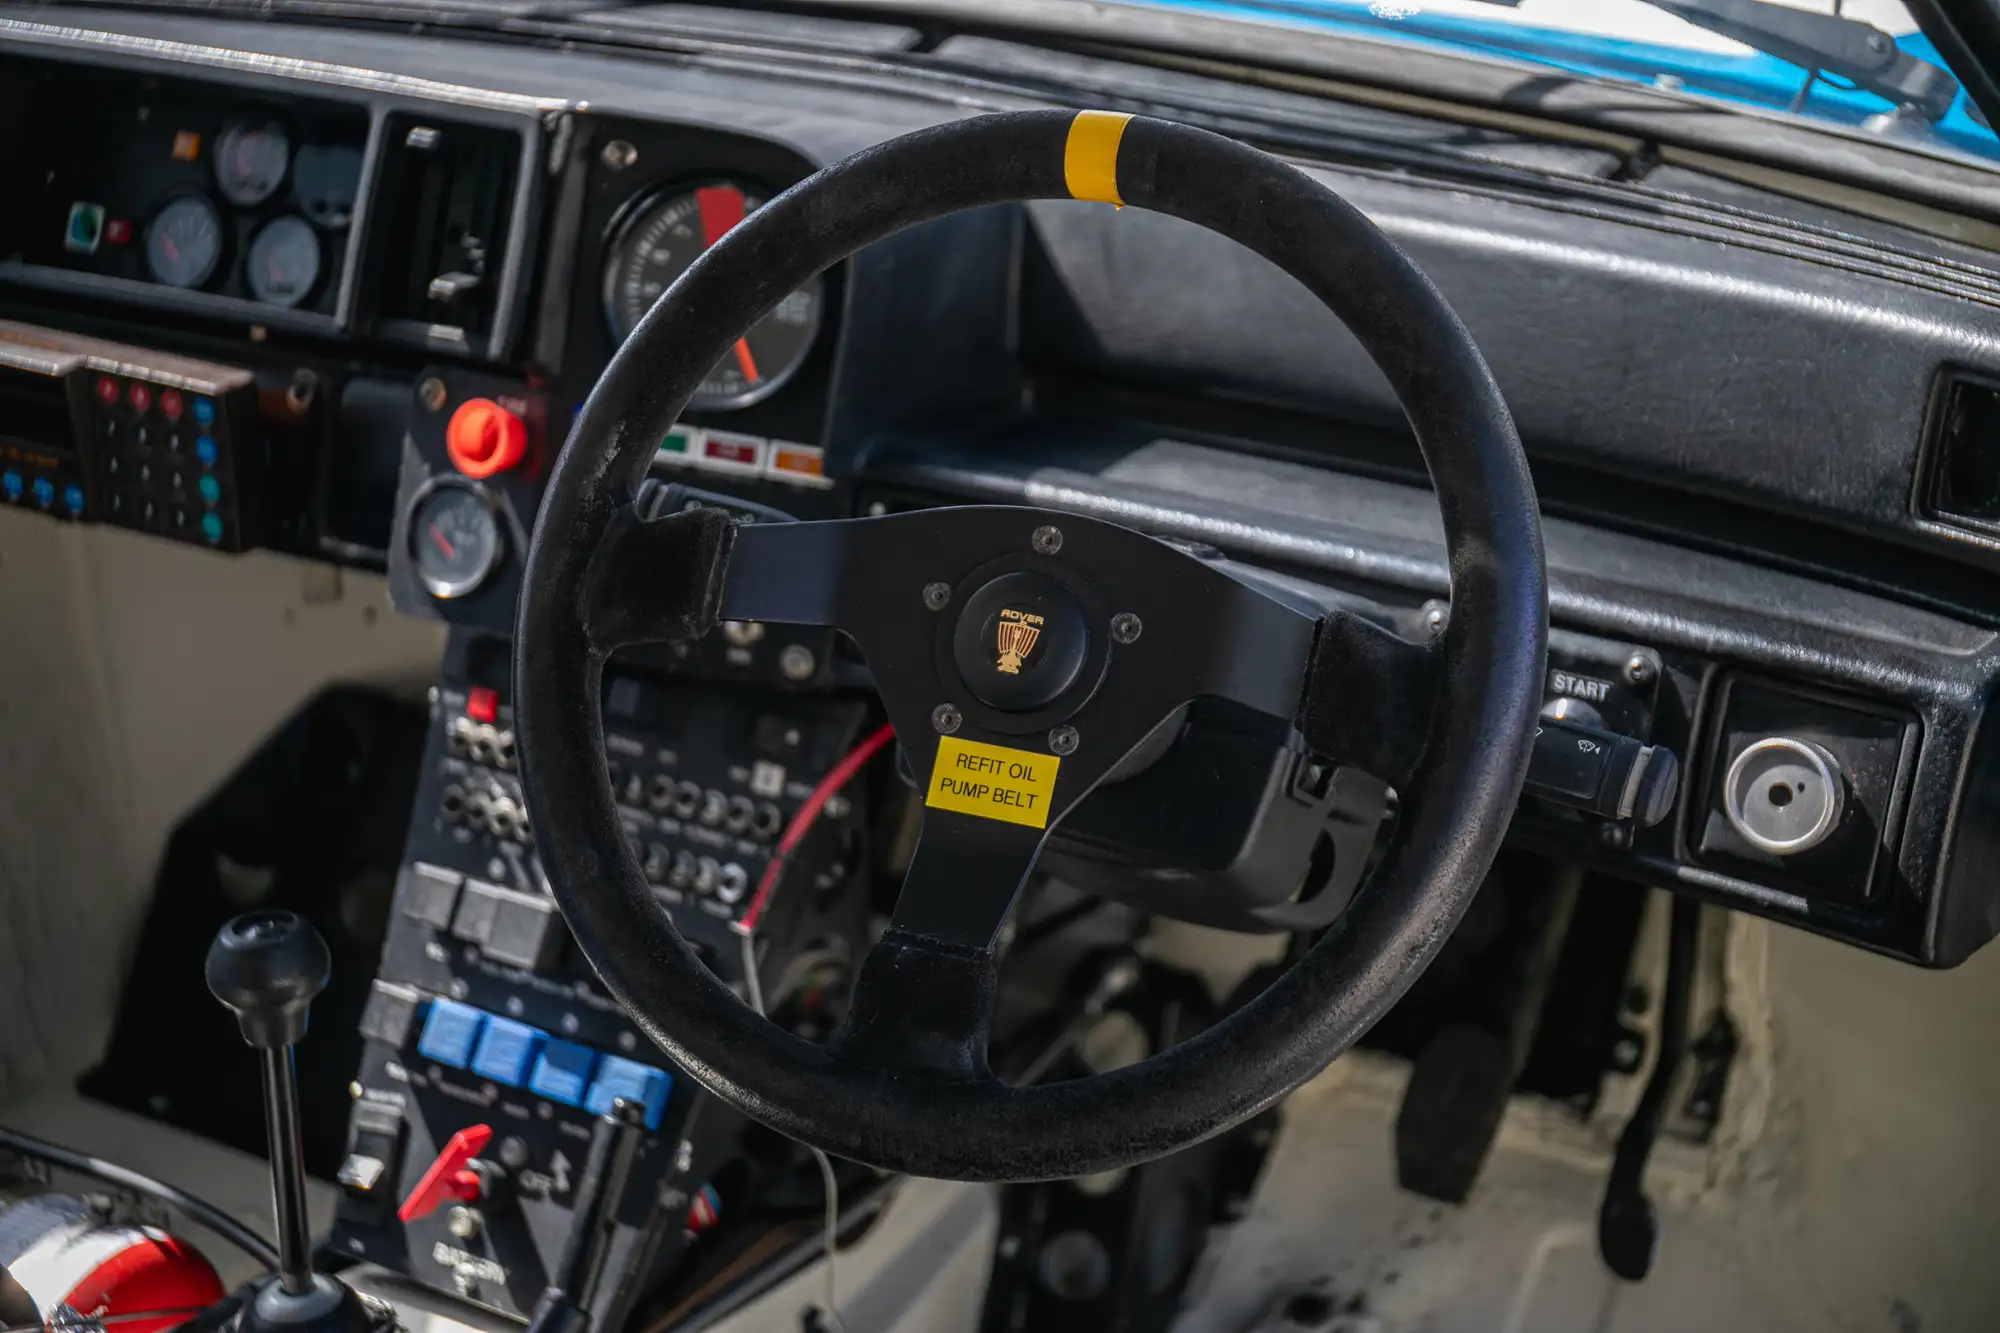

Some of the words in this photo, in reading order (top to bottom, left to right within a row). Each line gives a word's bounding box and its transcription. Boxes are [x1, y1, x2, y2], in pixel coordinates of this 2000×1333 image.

[1001, 609, 1044, 625] ROVER
[1554, 673, 1611, 703] START
[956, 752, 1006, 775] REFIT
[1008, 762, 1037, 782] OIL
[940, 777, 990, 799] PUMP
[992, 787, 1039, 809] BELT
